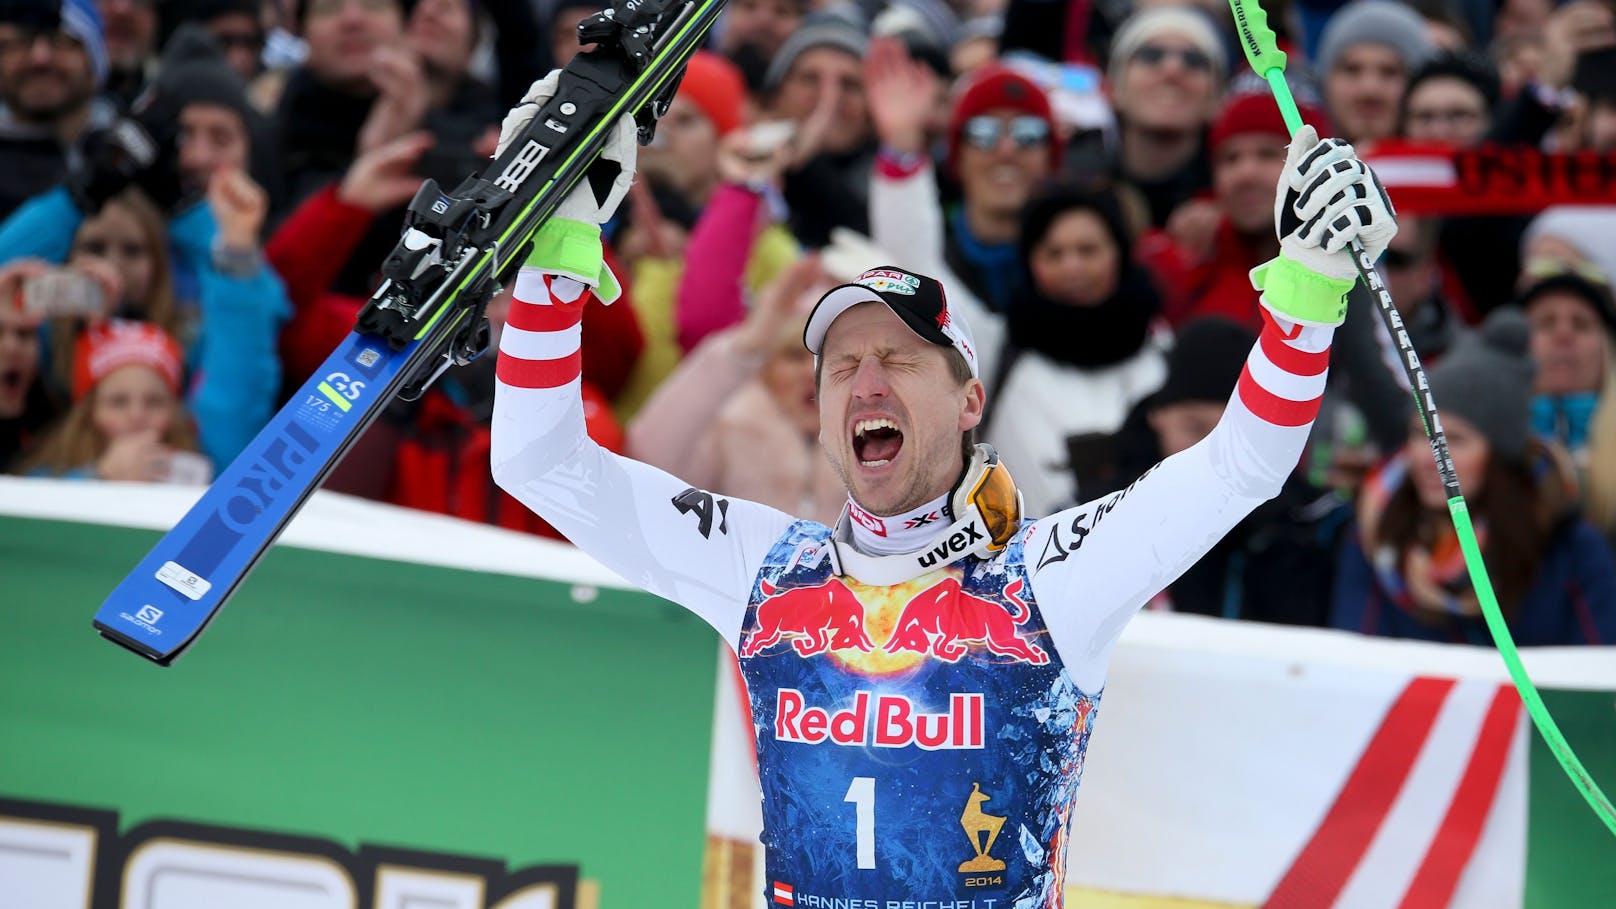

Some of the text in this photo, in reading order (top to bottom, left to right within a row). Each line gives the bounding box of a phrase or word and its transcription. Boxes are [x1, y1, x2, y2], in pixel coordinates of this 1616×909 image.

[326, 372, 366, 400] GS
[306, 395, 331, 411] 175
[918, 520, 984, 568] uvex
[120, 612, 162, 635] salomon
[777, 690, 984, 749] Red Bull
[844, 777, 876, 870] 1
[965, 876, 1002, 887] 2014
[797, 893, 878, 909] HANNES
